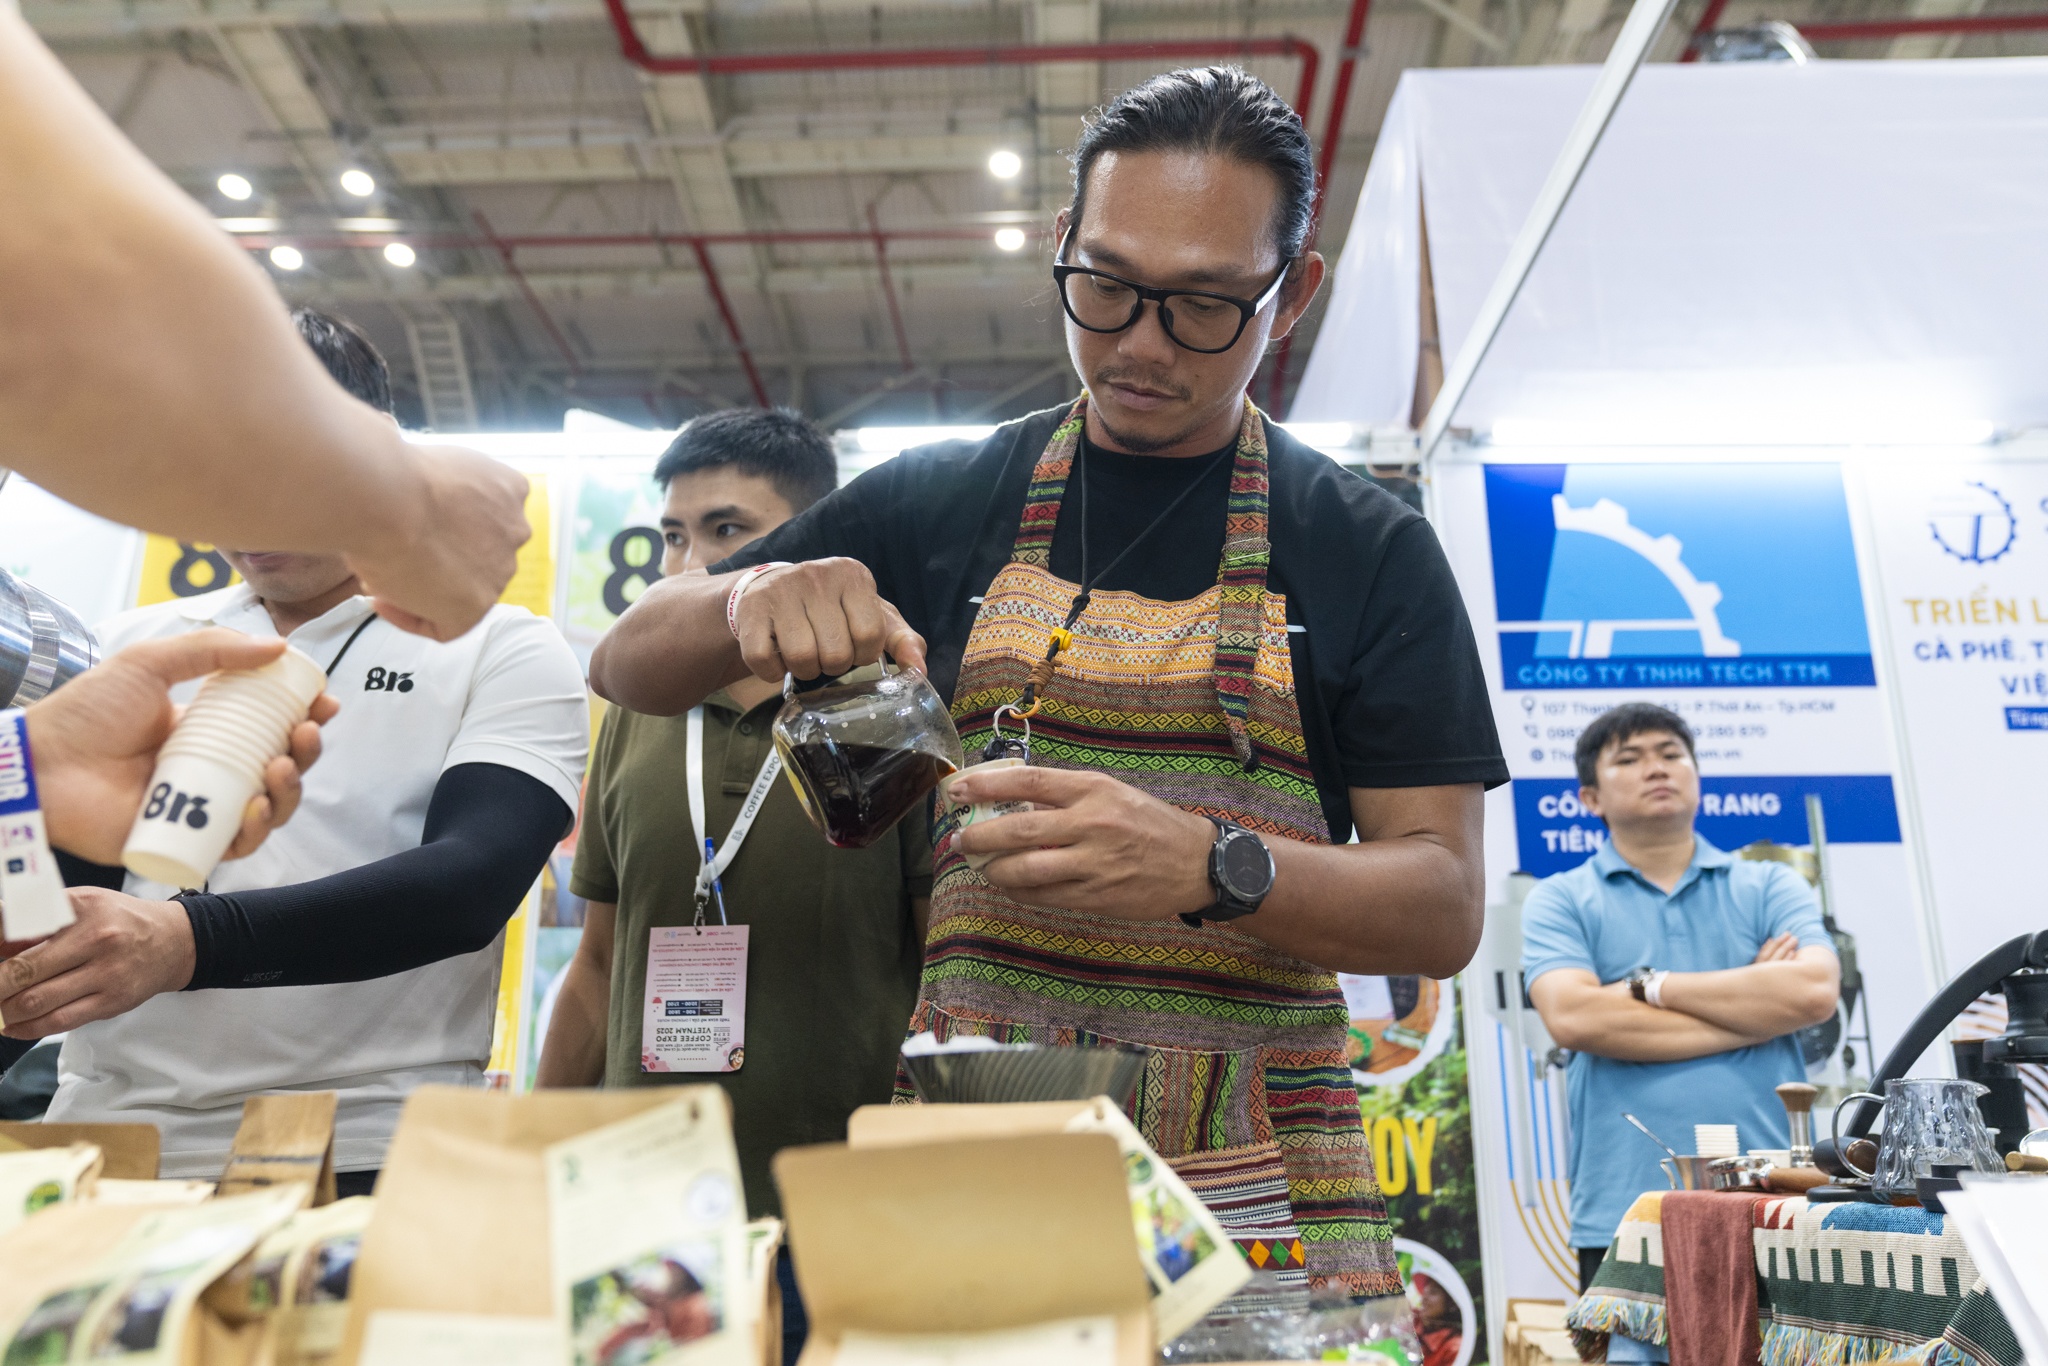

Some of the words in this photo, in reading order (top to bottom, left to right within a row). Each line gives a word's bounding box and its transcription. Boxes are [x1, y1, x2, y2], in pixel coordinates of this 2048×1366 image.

[728, 590, 739, 617] NEVER
[1904, 583, 2019, 624] TRIỂN
[1914, 635, 1952, 661] CÀ
[1517, 661, 1589, 683] CÔNG
[1595, 663, 1626, 682] TY
[1635, 662, 1702, 682] TNHH
[1708, 662, 1773, 681] TECH
[1778, 662, 1831, 681] TTM
[744, 782, 767, 819] COFFEE
[763, 756, 779, 781] EXPO
[993, 801, 1011, 813] NEW
[1363, 1117, 1437, 1196] OY
